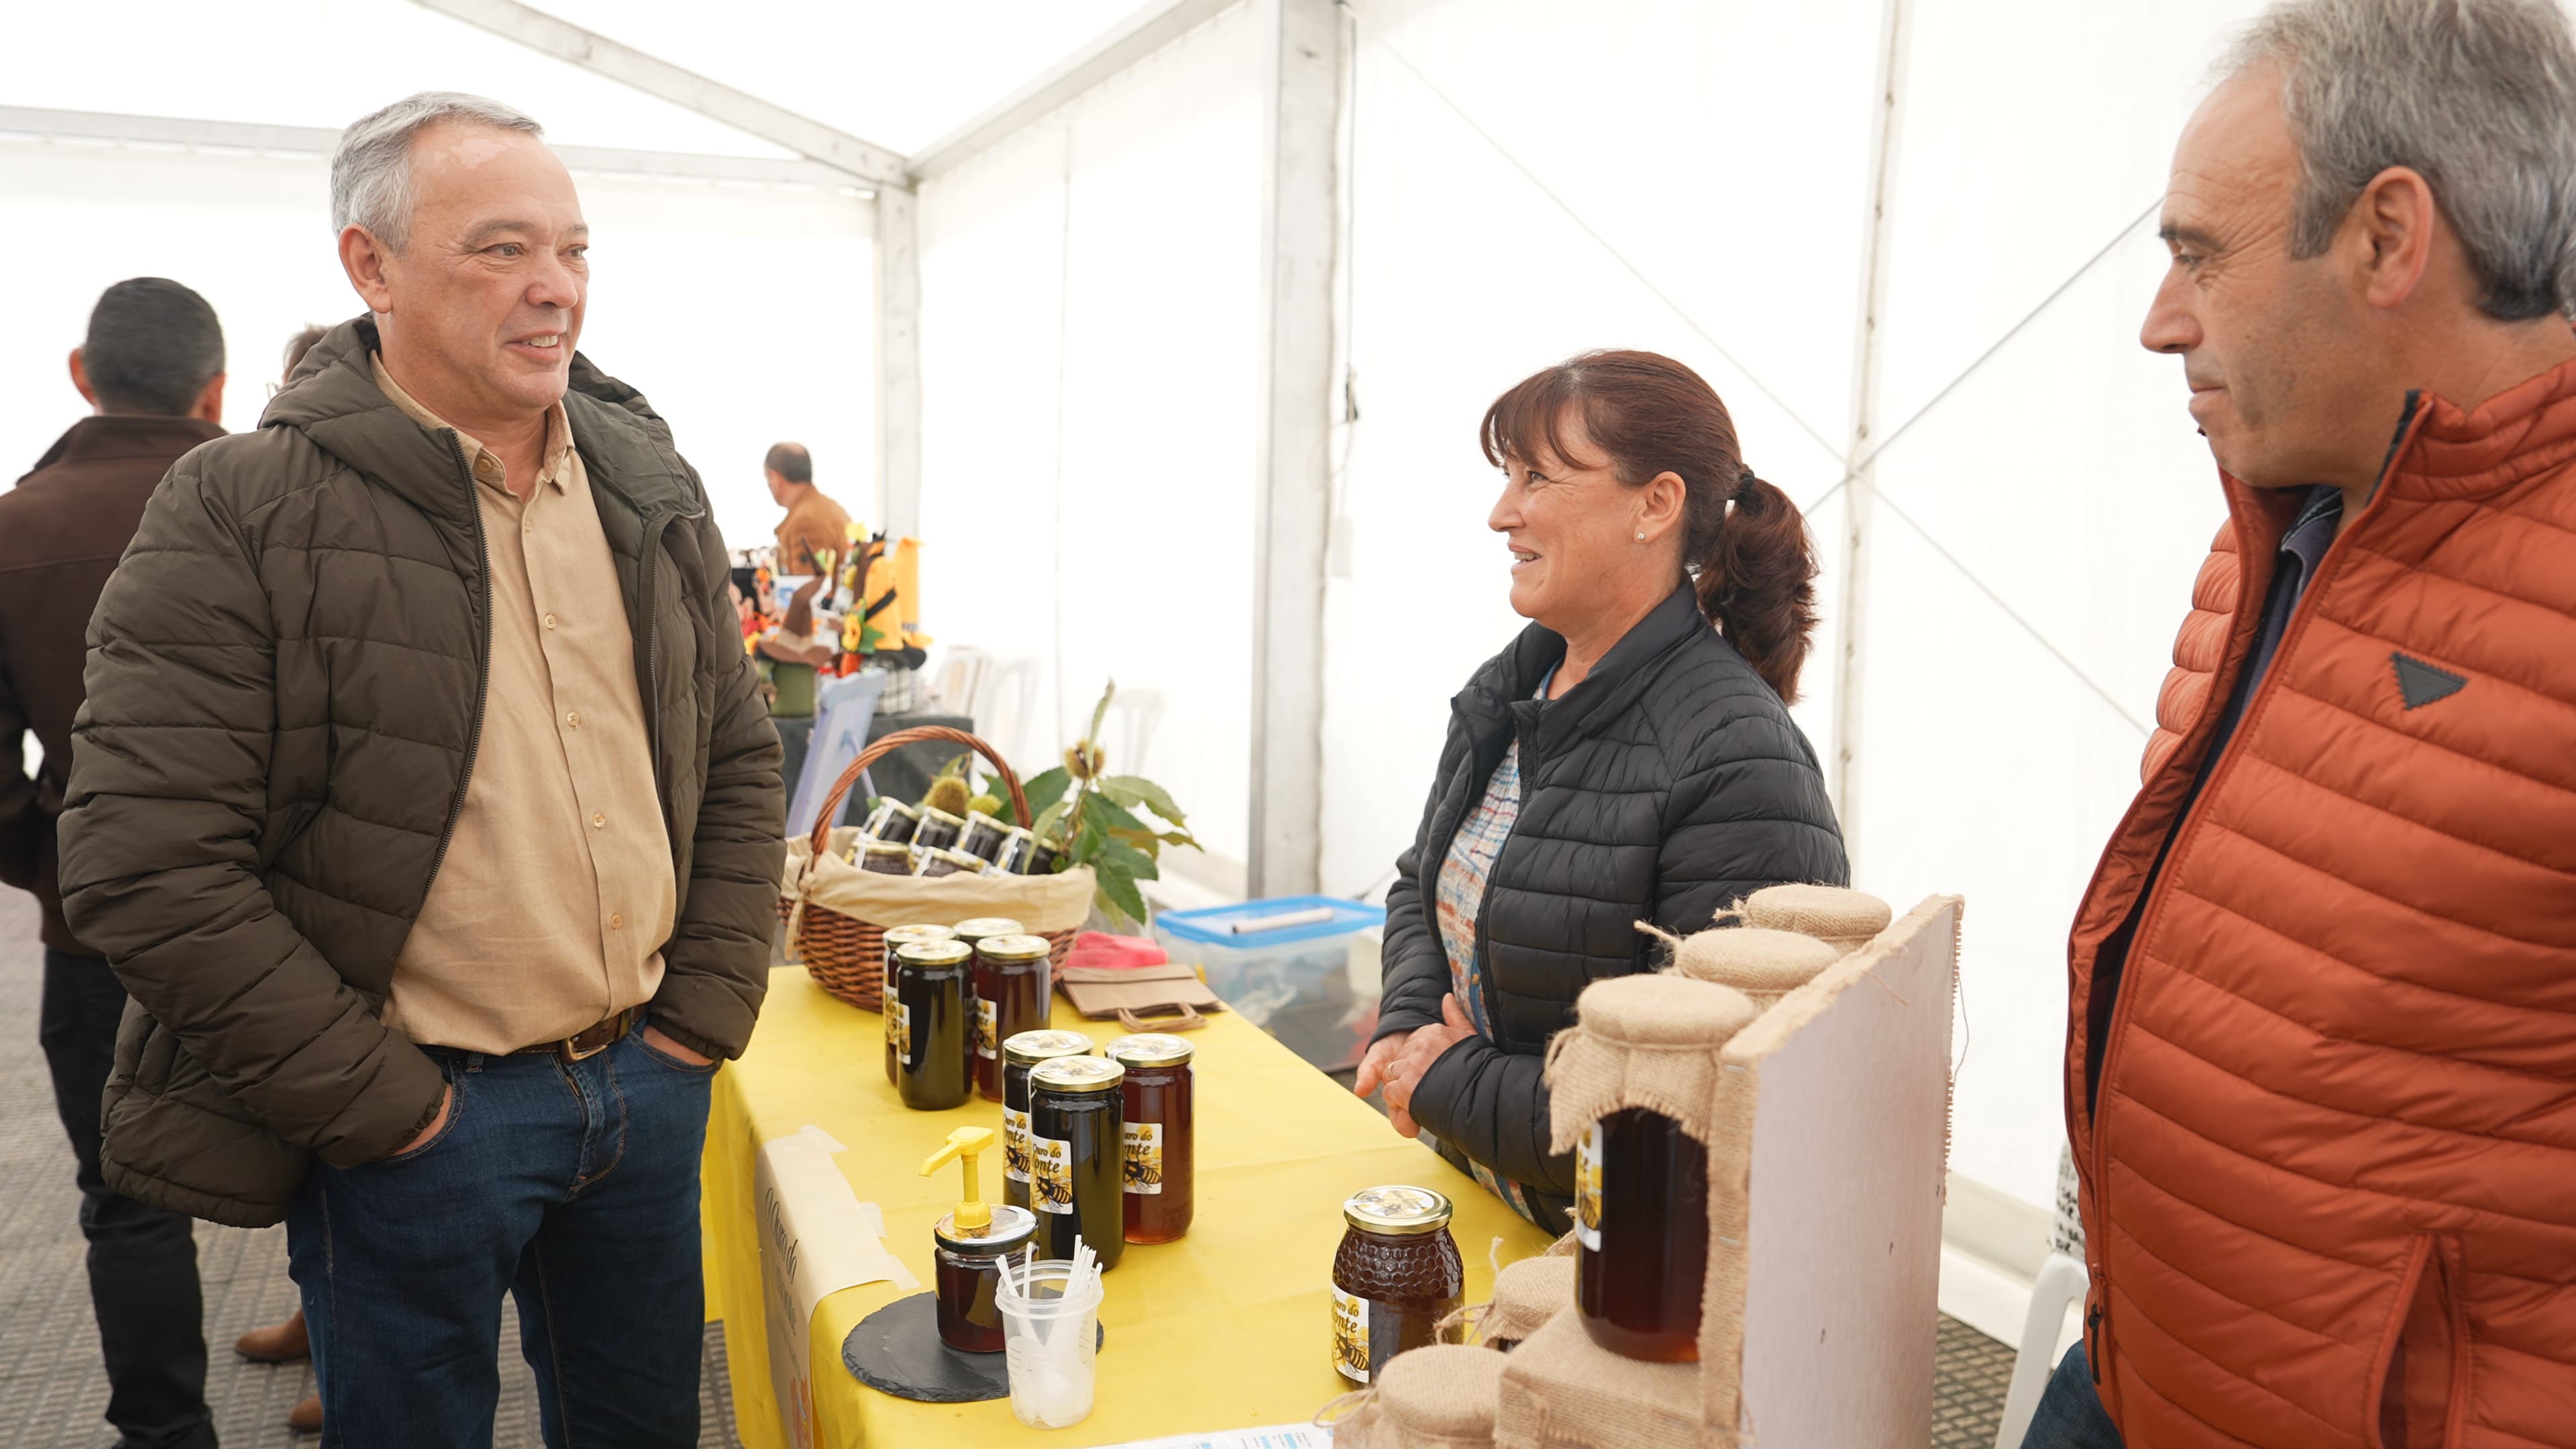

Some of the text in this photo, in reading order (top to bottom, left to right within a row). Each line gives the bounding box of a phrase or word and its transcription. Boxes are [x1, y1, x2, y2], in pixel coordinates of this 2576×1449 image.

[1016, 1118, 1026, 1130] do
[1140, 1130, 1153, 1141] do
[1050, 1147, 1061, 1159] do
[1034, 1159, 1060, 1173] onte
[786, 1238, 798, 1285] do
[1348, 1303, 1359, 1318] do
[1333, 1311, 1358, 1334] onte
